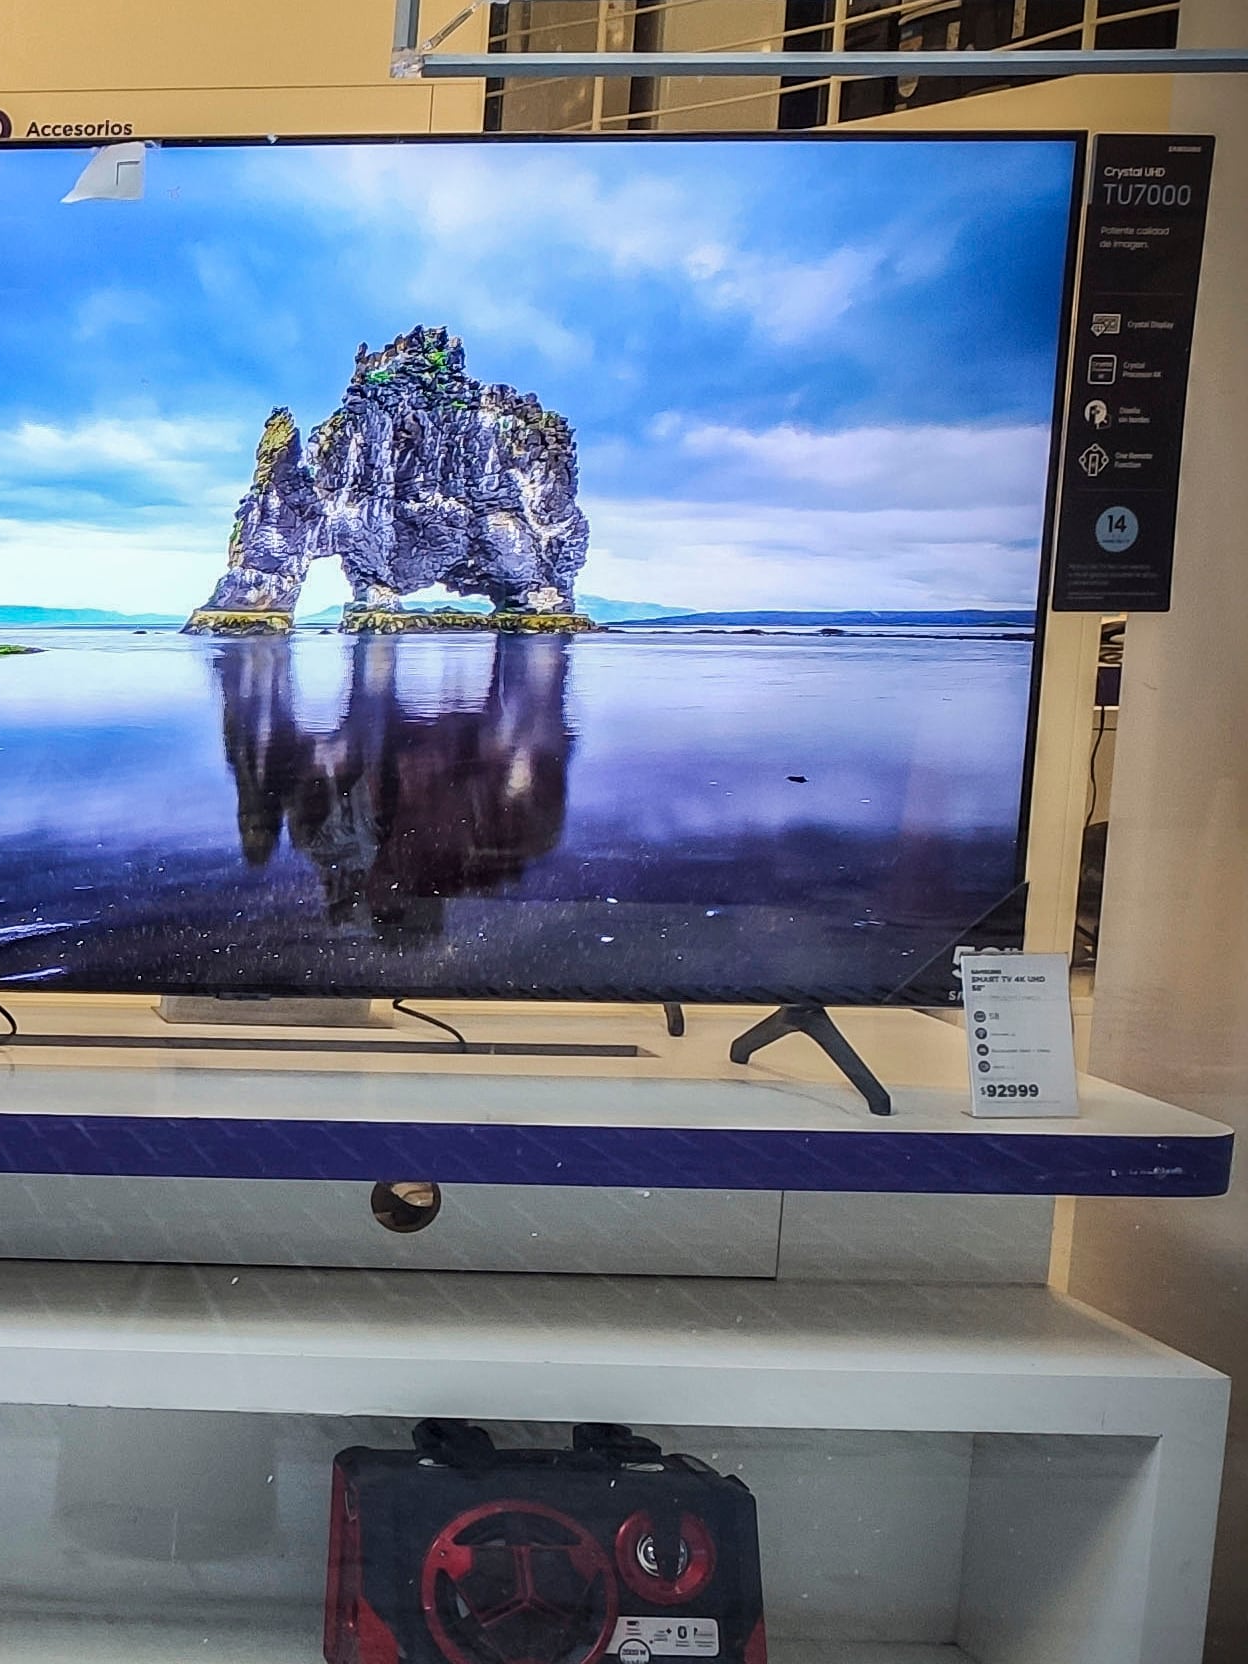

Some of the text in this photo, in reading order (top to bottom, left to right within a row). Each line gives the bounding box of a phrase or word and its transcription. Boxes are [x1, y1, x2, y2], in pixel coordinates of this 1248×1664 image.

[26, 120, 133, 137] Accesorios
[1104, 166, 1166, 178] Crystal UHD
[1103, 183, 1192, 206] TU7000
[1108, 514, 1128, 533] 14
[980, 1084, 1039, 1098] $92999
